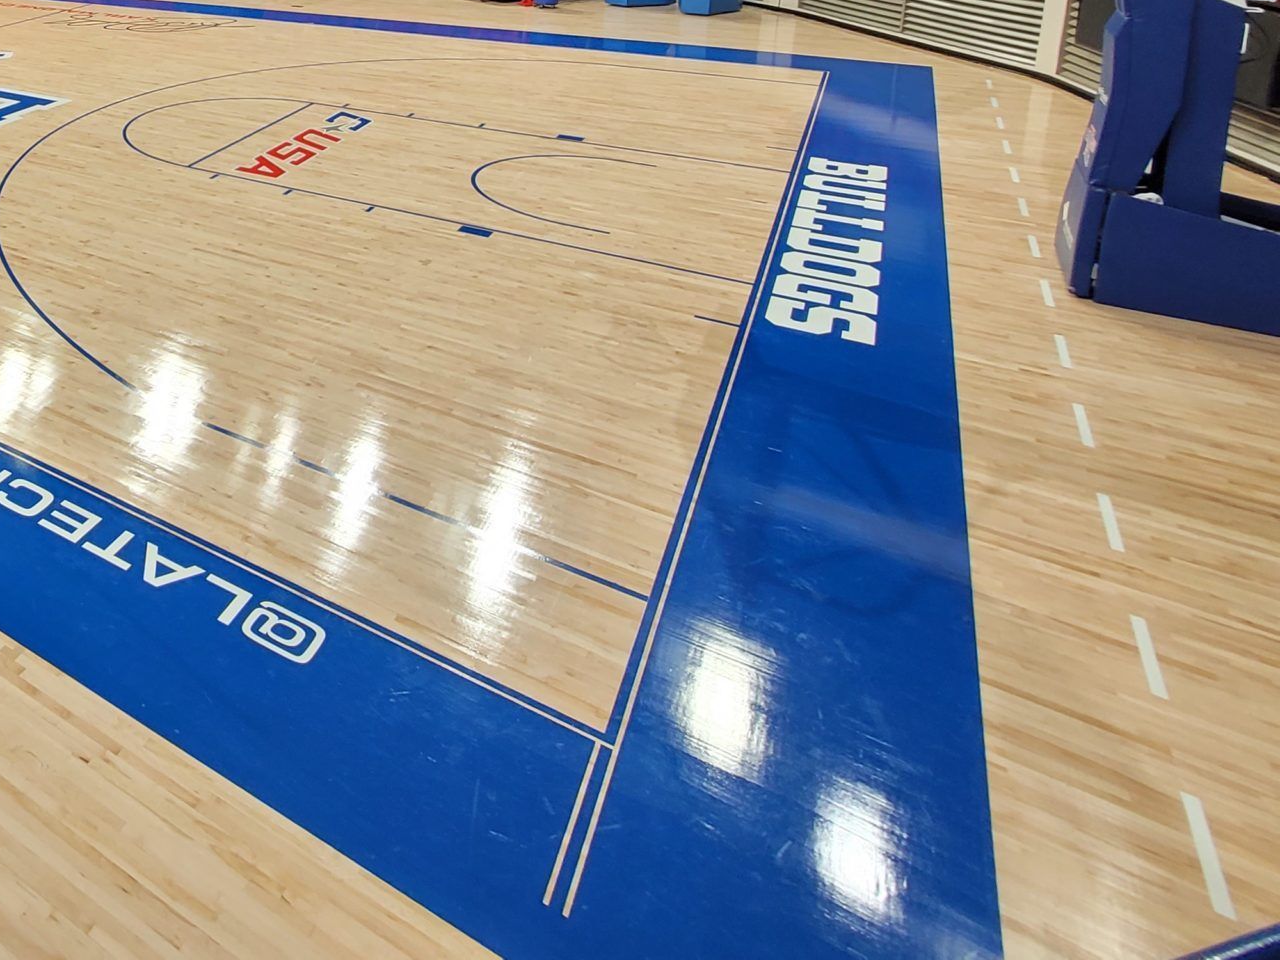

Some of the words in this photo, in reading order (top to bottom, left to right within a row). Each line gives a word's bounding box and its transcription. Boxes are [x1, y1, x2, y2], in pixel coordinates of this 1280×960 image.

[325, 111, 373, 132] C
[234, 128, 342, 179] USA
[765, 157, 888, 346] BULLDOGS
